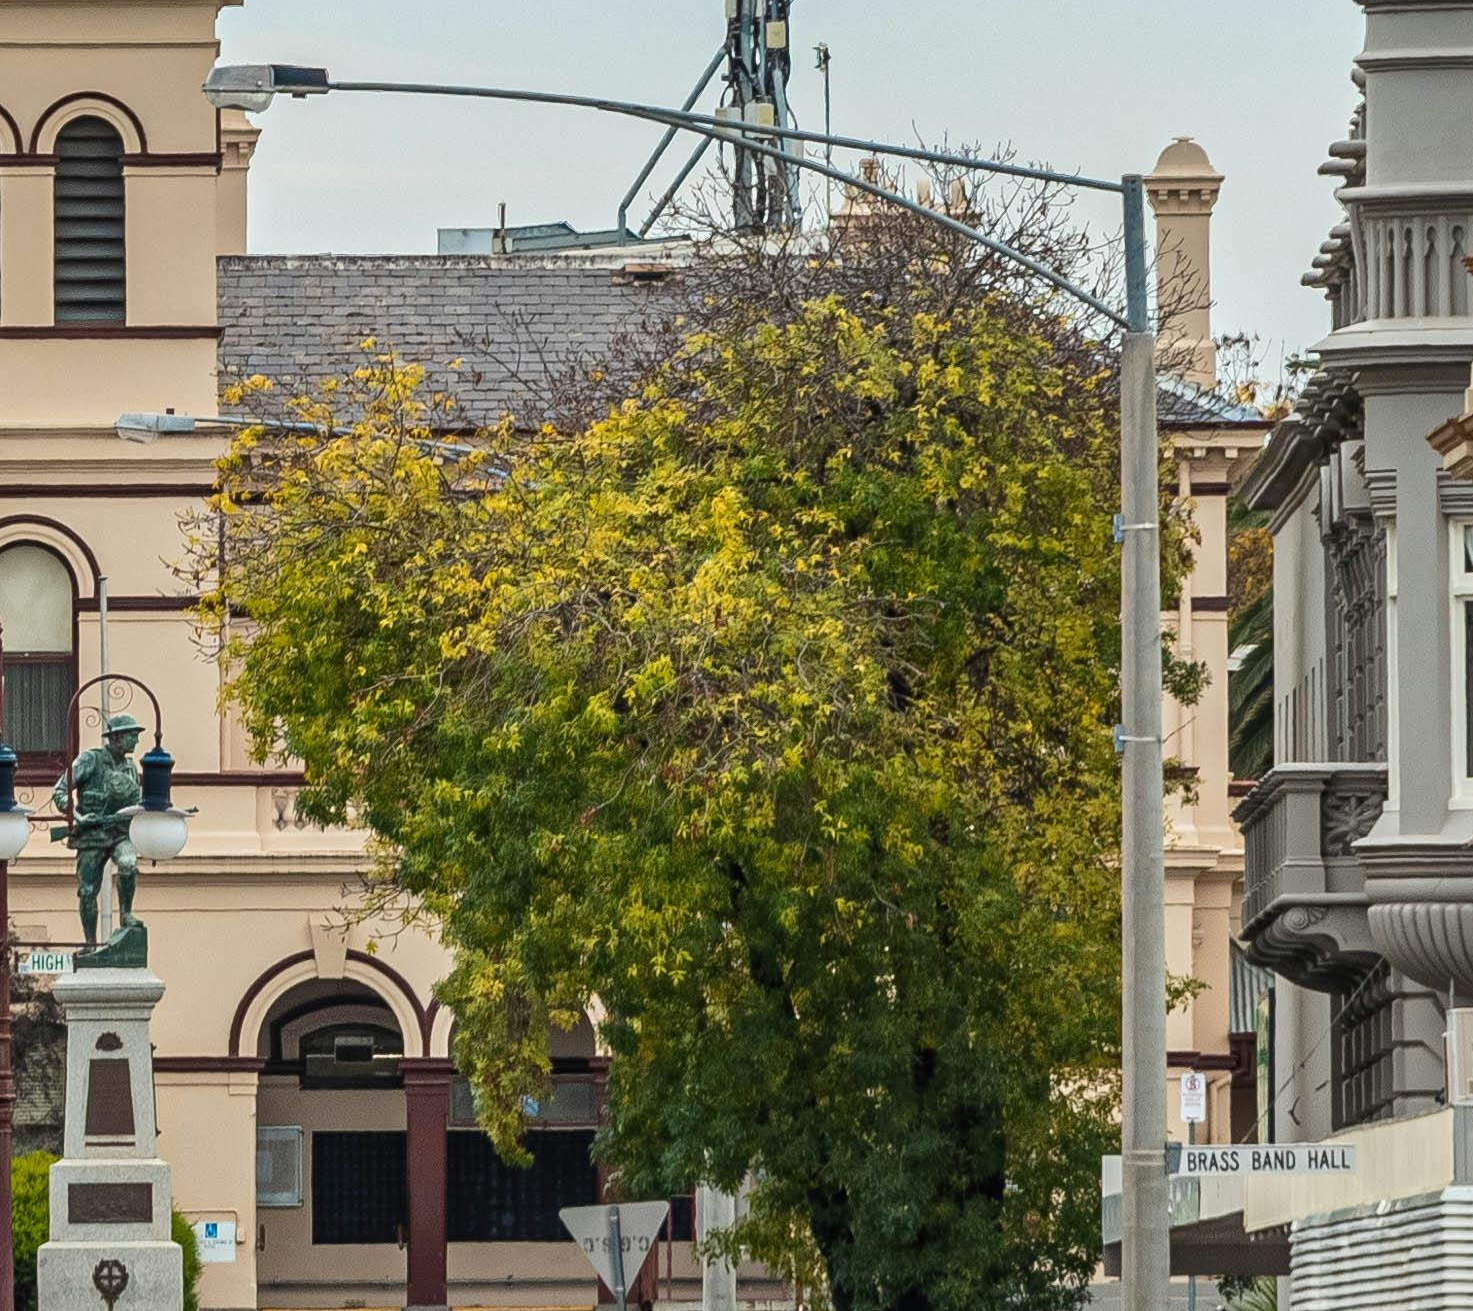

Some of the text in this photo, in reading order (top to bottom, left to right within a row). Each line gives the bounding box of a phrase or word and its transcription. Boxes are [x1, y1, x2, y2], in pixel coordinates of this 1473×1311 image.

[32, 954, 64, 971] HIGH
[1187, 1149, 1351, 1172] BRASS BAND HALL
